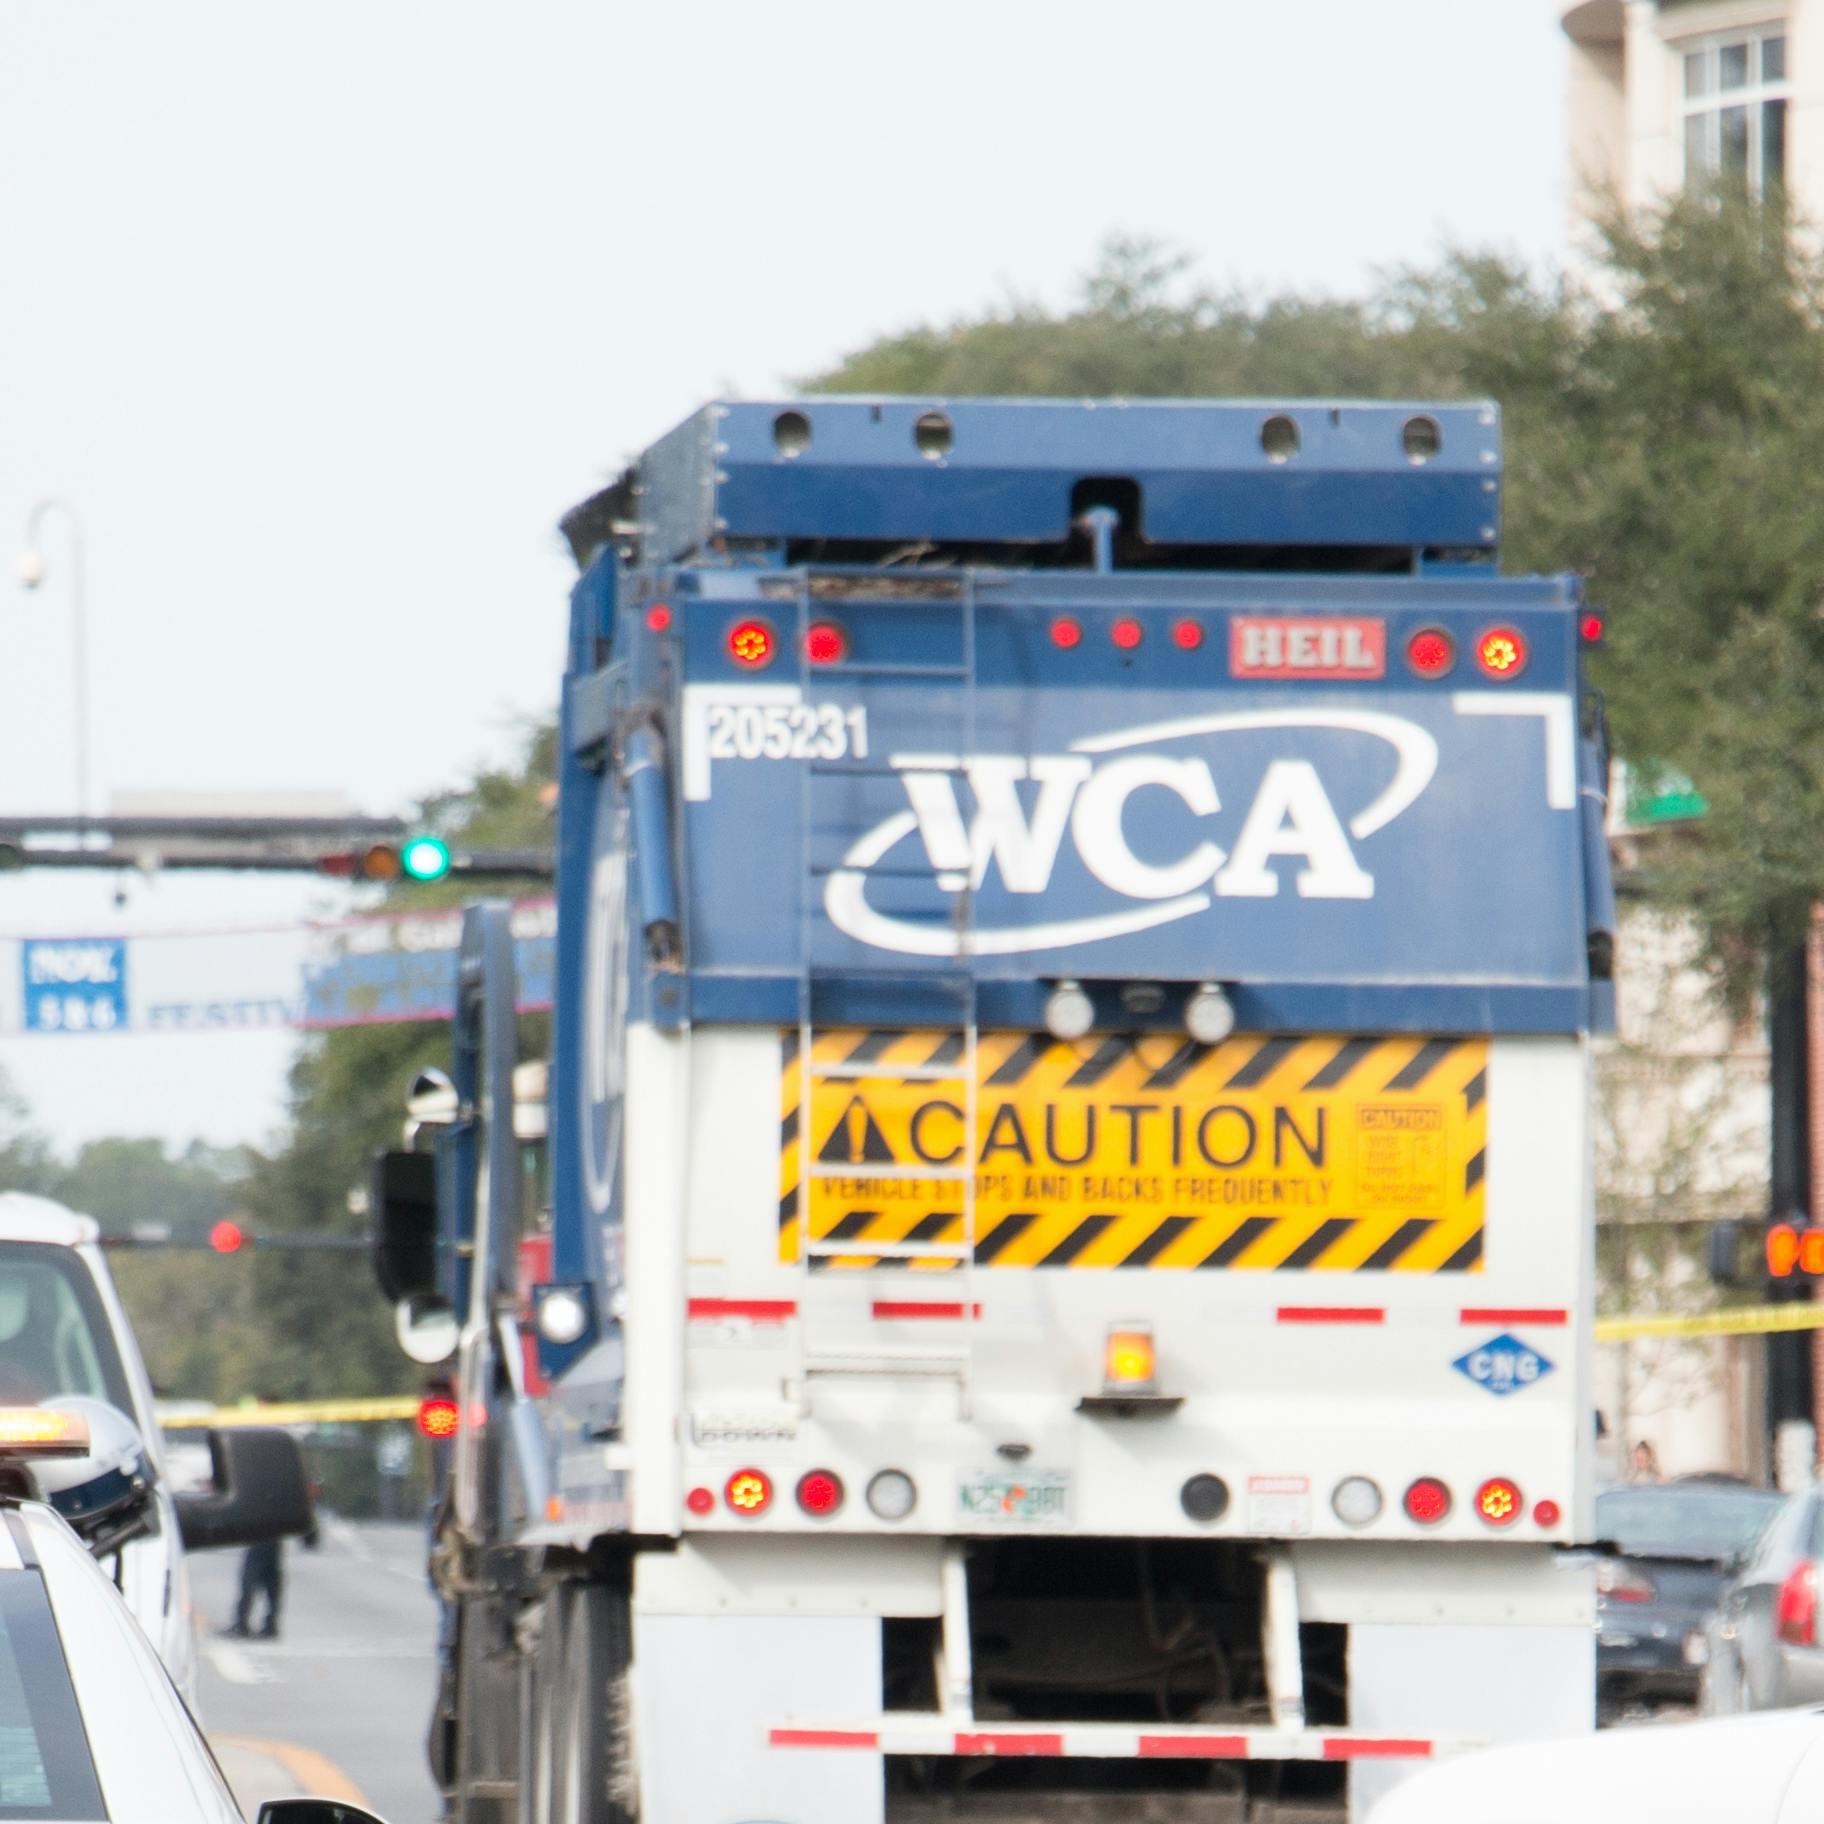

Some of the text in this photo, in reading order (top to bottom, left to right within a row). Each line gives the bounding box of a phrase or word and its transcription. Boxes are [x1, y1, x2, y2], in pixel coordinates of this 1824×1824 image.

[1238, 616, 1377, 669] HEIL
[713, 703, 868, 758] 205231
[888, 753, 1375, 899] WCA
[908, 1099, 1329, 1169] CAUTION
[820, 1174, 921, 1203] VEHICLE
[930, 1175, 1014, 1204] STOPS
[1021, 1175, 1073, 1204] AND
[1081, 1176, 1163, 1205] BACKS
[1173, 1177, 1334, 1206] FREQUENTLY
[1467, 1351, 1541, 1382] CNG
